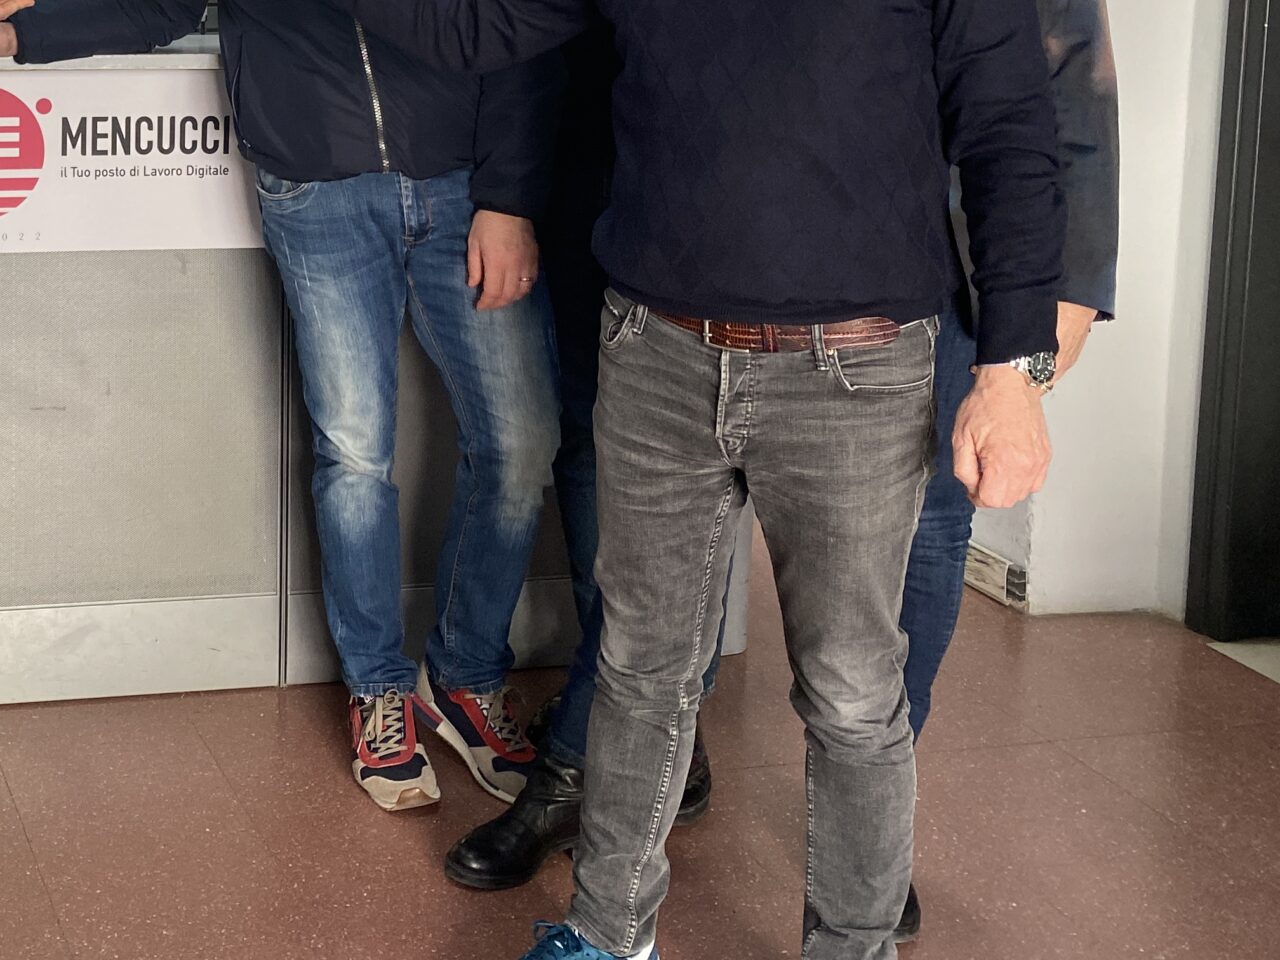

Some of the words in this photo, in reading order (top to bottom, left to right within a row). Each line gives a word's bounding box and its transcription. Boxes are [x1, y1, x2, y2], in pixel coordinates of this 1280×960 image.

[61, 115, 230, 157] MENCUCCI
[60, 166, 67, 178] il
[70, 166, 91, 178] Tuo
[94, 166, 126, 180] posto
[129, 165, 140, 177] di
[143, 165, 183, 177] Lavoro
[186, 164, 230, 179] Digitale
